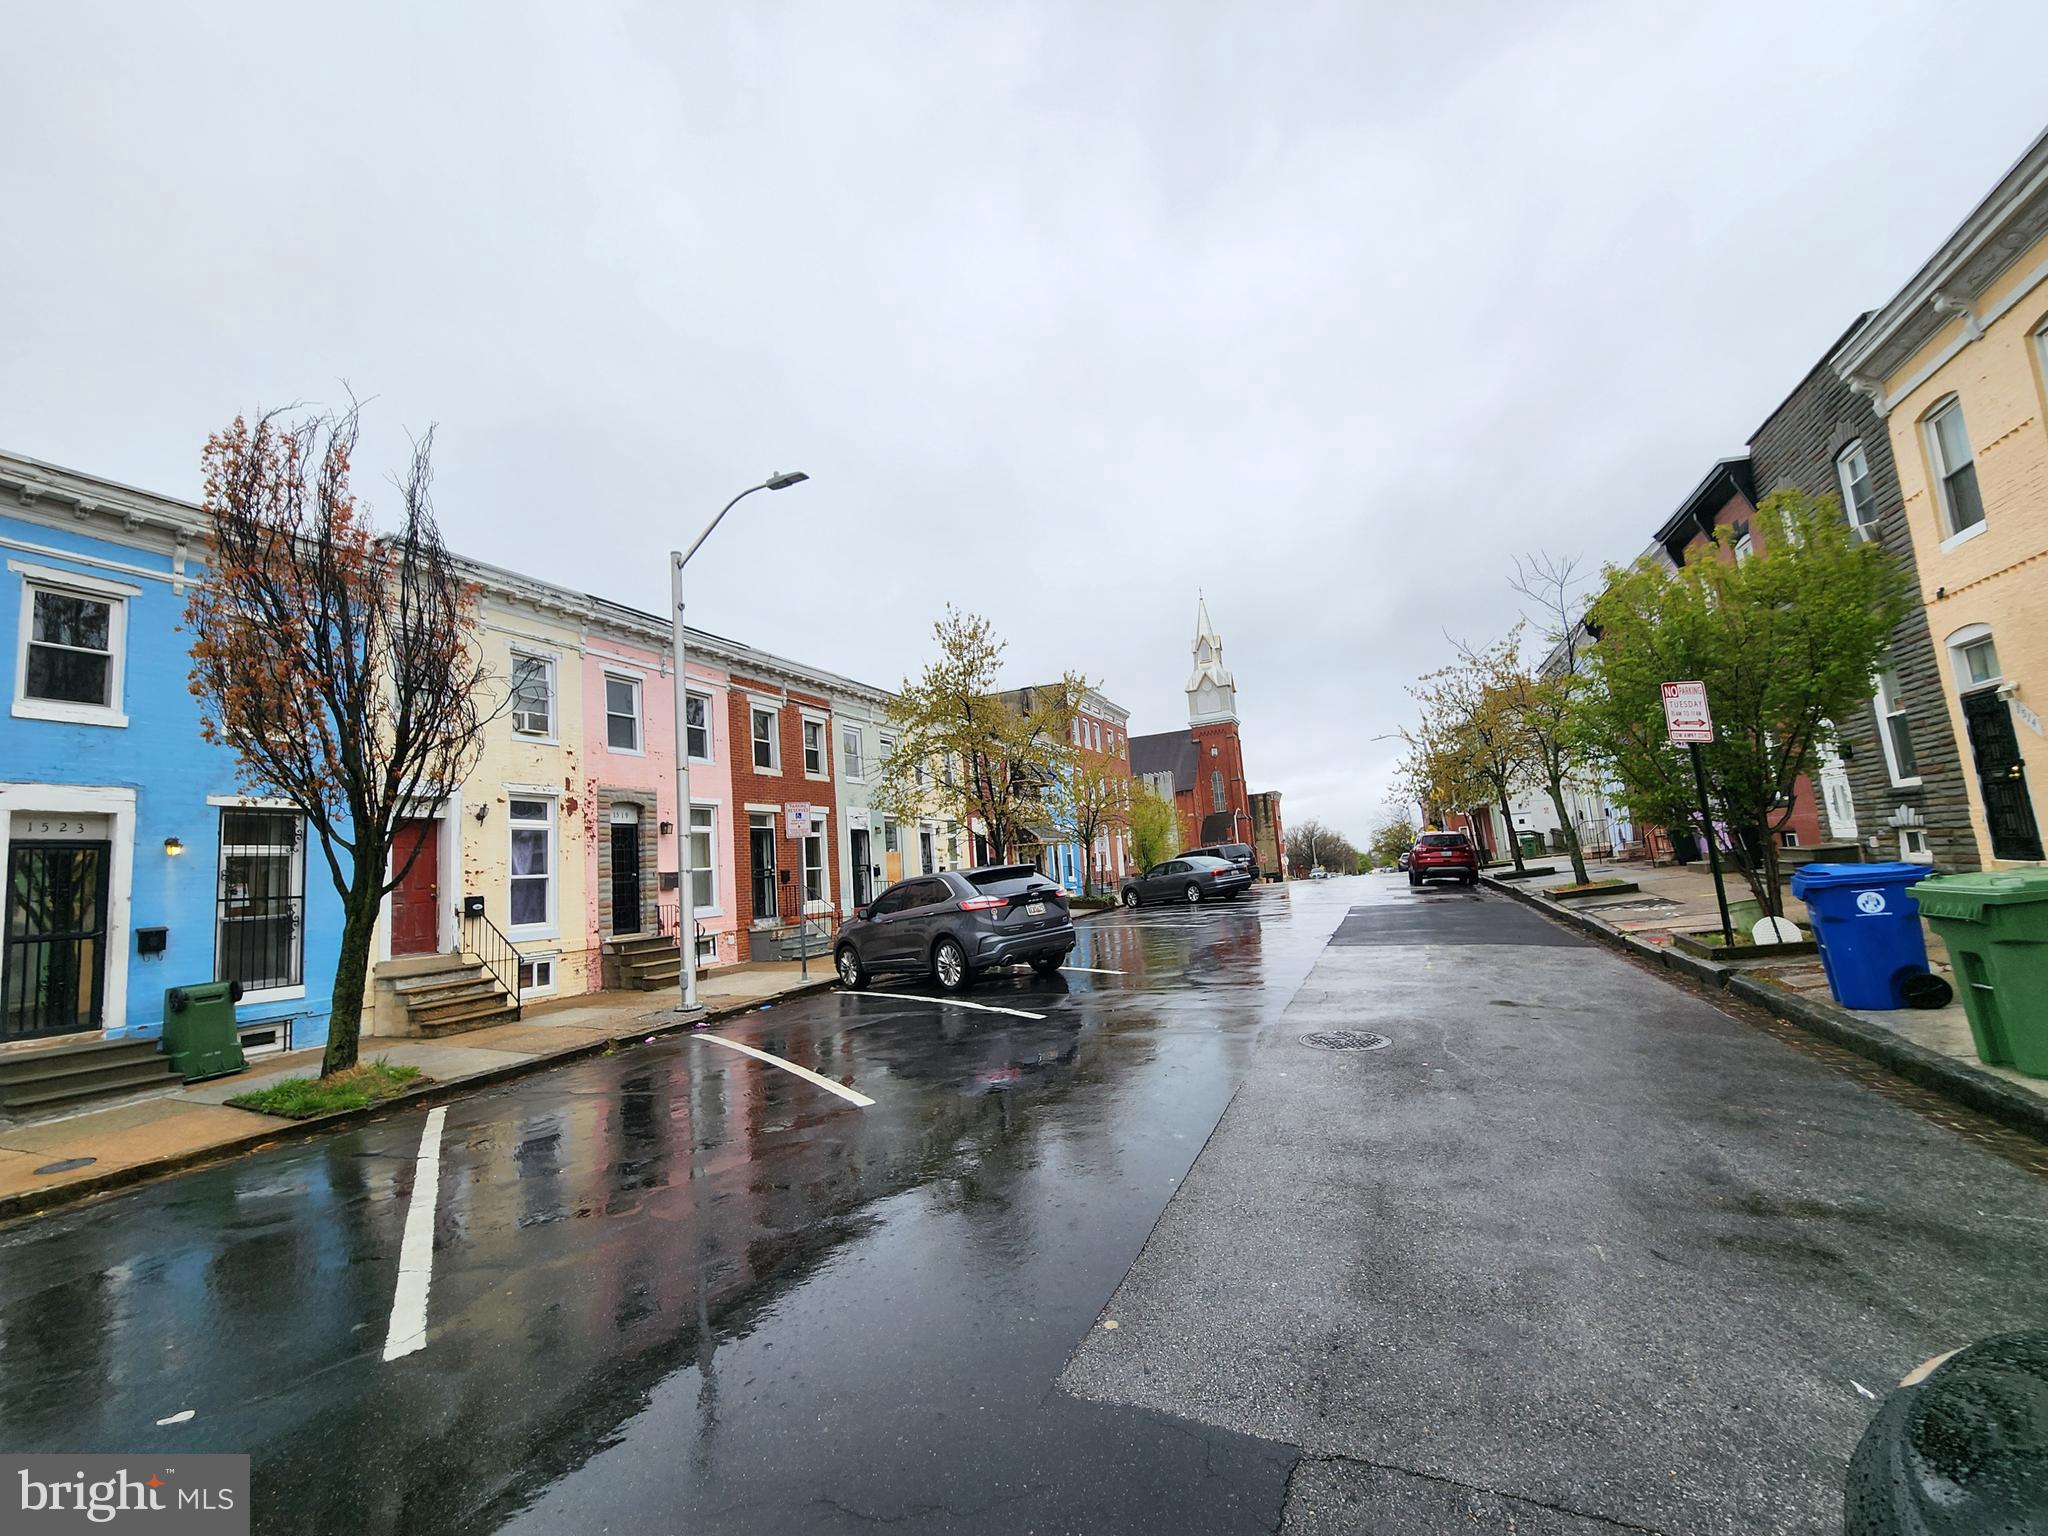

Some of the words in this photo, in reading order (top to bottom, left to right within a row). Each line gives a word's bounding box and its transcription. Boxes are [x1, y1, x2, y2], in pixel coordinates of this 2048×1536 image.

[1664, 686, 1678, 697] NO
[1679, 685, 1702, 695] PARKING
[1668, 700, 1702, 708] TUESDAY
[613, 811, 629, 819] 1519
[26, 822, 85, 834] 1523
